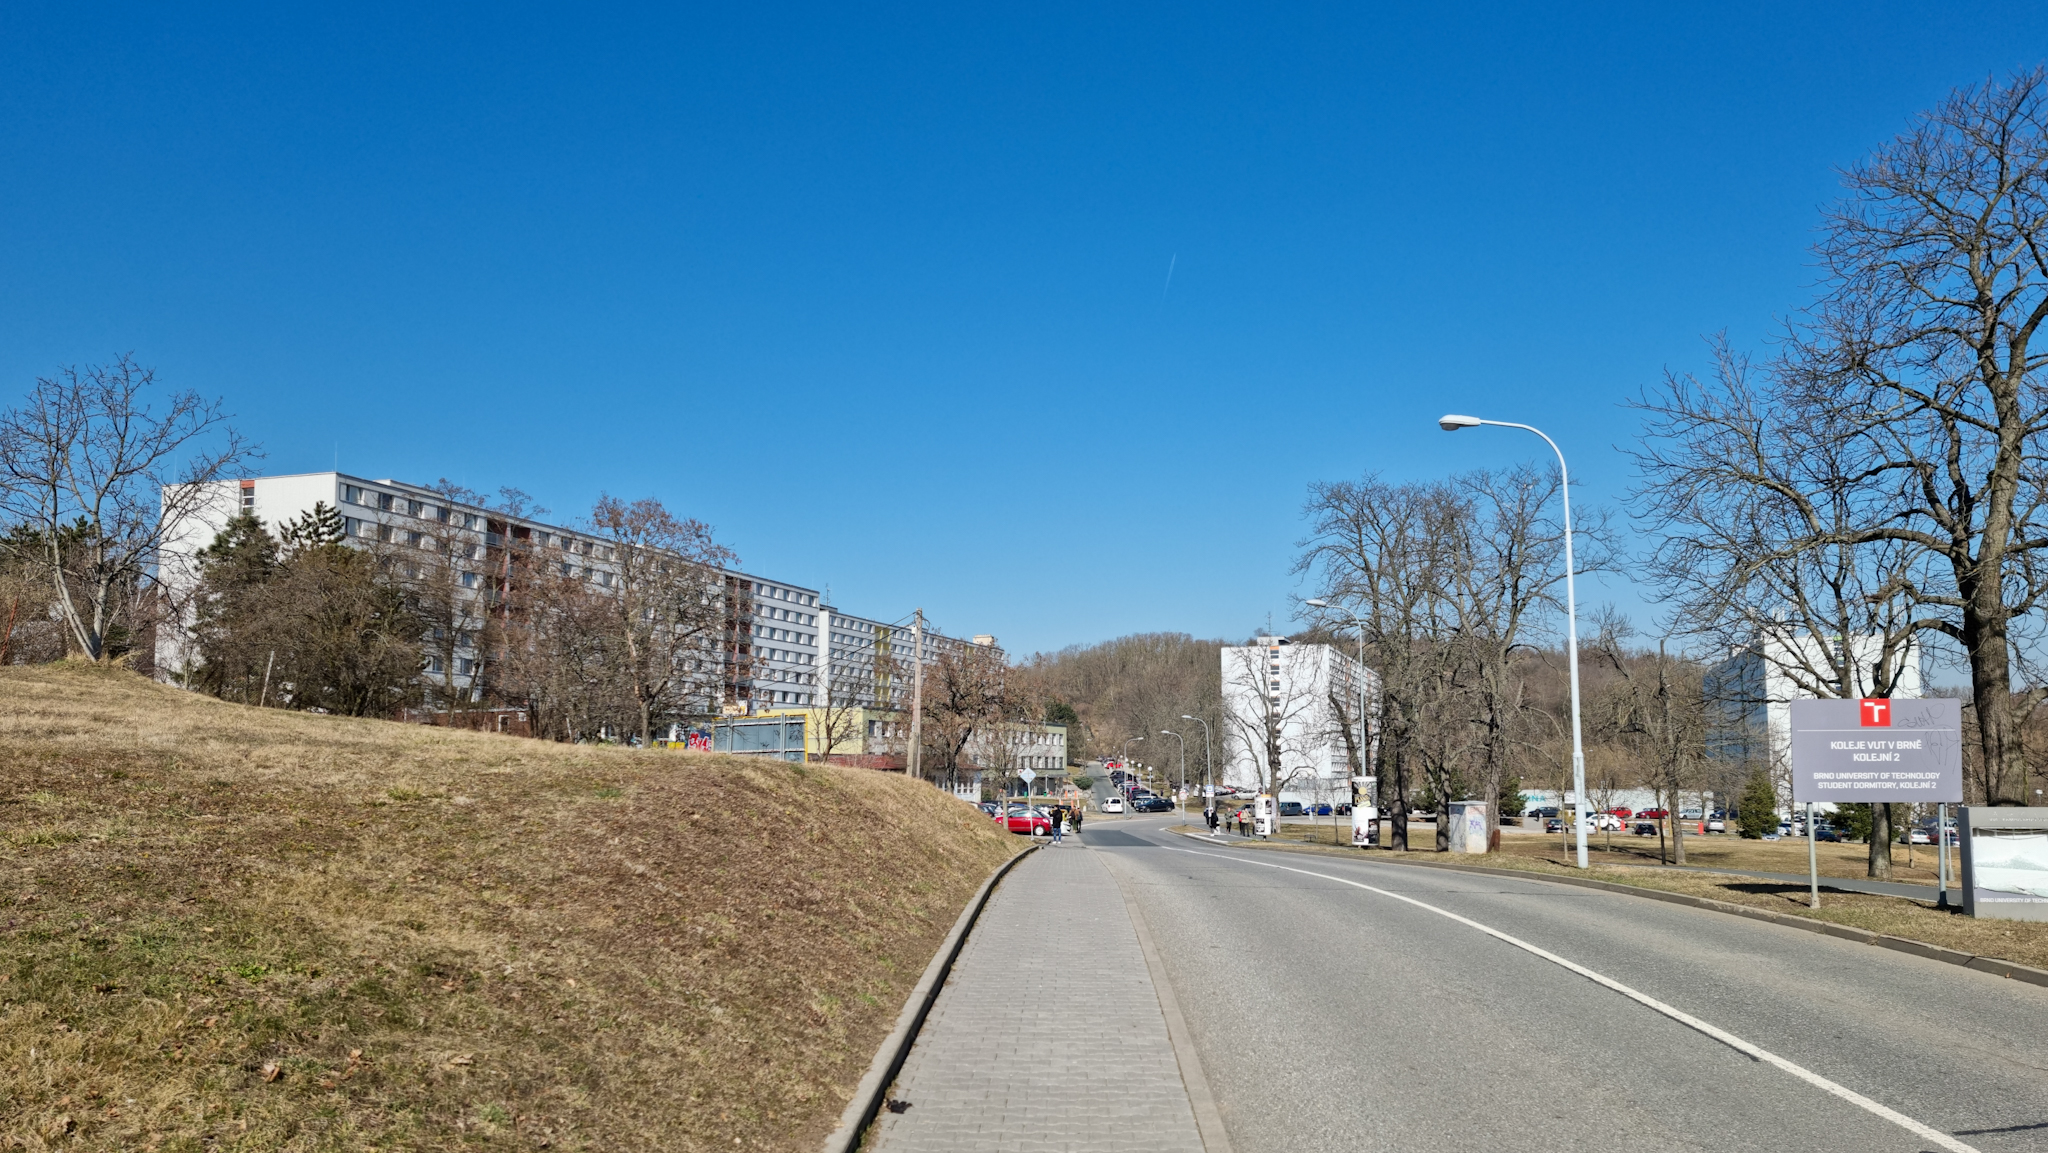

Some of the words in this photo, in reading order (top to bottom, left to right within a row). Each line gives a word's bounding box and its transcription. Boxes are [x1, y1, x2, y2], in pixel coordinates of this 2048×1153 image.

[1830, 741, 1866, 750] KOLEJE
[1867, 741, 1886, 750] VUT
[1888, 741, 1895, 750] V
[1896, 739, 1922, 750] BRNĚ
[1853, 752, 1892, 762] KOLEJNÍ
[1893, 753, 1900, 762] 2
[1813, 772, 1835, 780] BRNO
[1836, 772, 1879, 780] UNIVERSITY
[1880, 772, 1890, 780] OF
[1891, 772, 1940, 780] TECHNOLOGY
[1853, 782, 1899, 790] DORMITORY,
[1900, 781, 1930, 789] KOLEJNÍ
